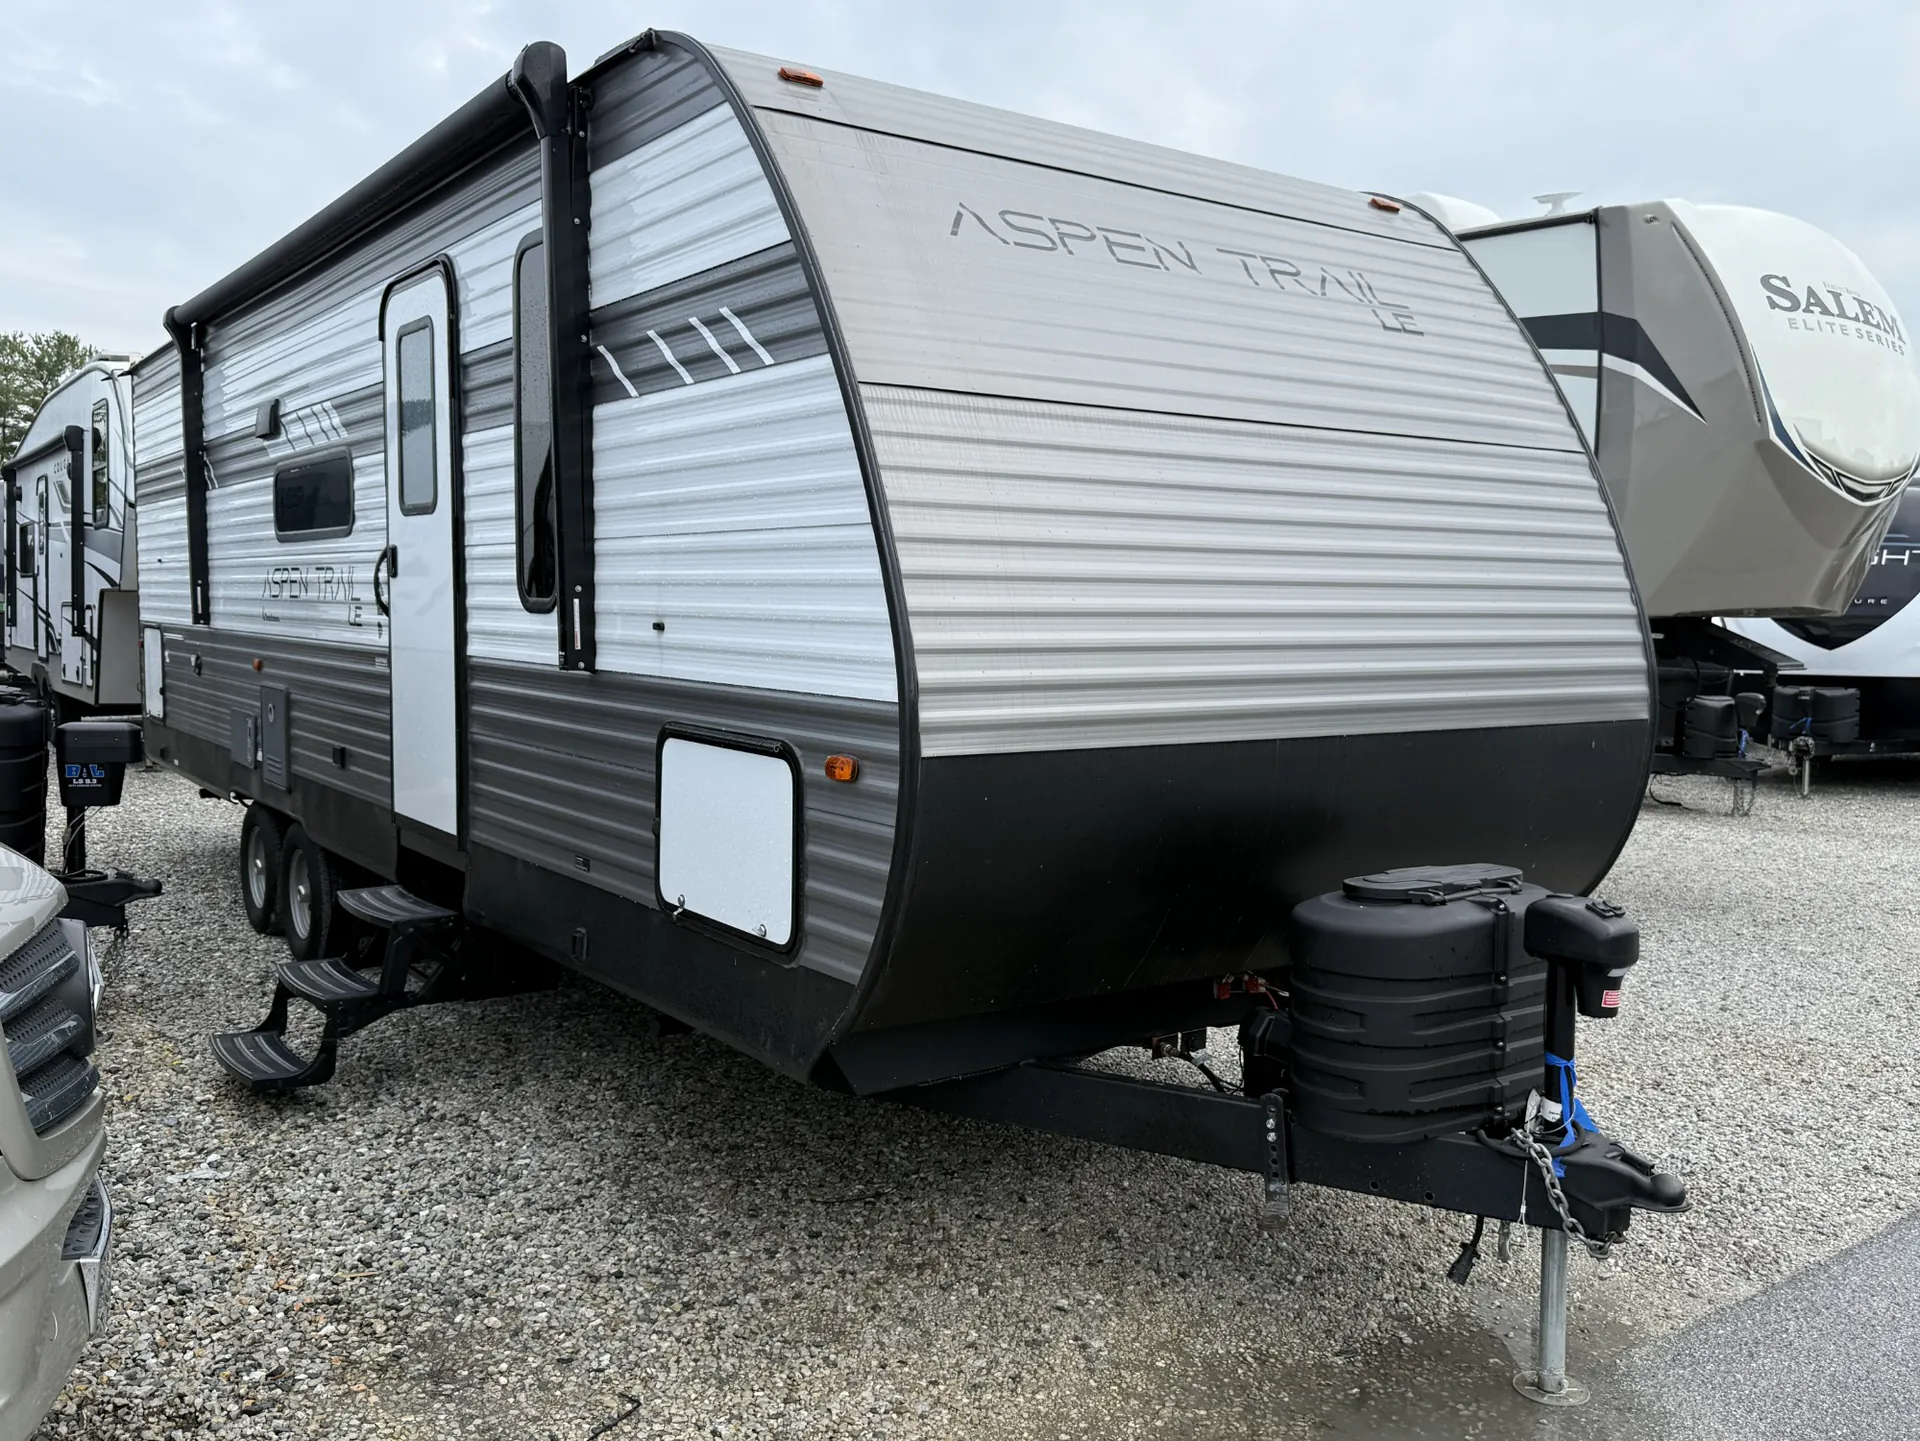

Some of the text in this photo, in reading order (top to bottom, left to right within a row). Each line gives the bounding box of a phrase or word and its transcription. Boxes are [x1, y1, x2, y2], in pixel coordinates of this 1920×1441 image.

[950, 202, 1410, 309] ASPEN TRAIL
[1371, 309, 1424, 337] LE
[1760, 274, 1907, 345] SALEM
[1787, 317, 1905, 357] ELITE SERIES
[262, 566, 361, 602] ASPEN TRAIL
[348, 604, 363, 627] LE
